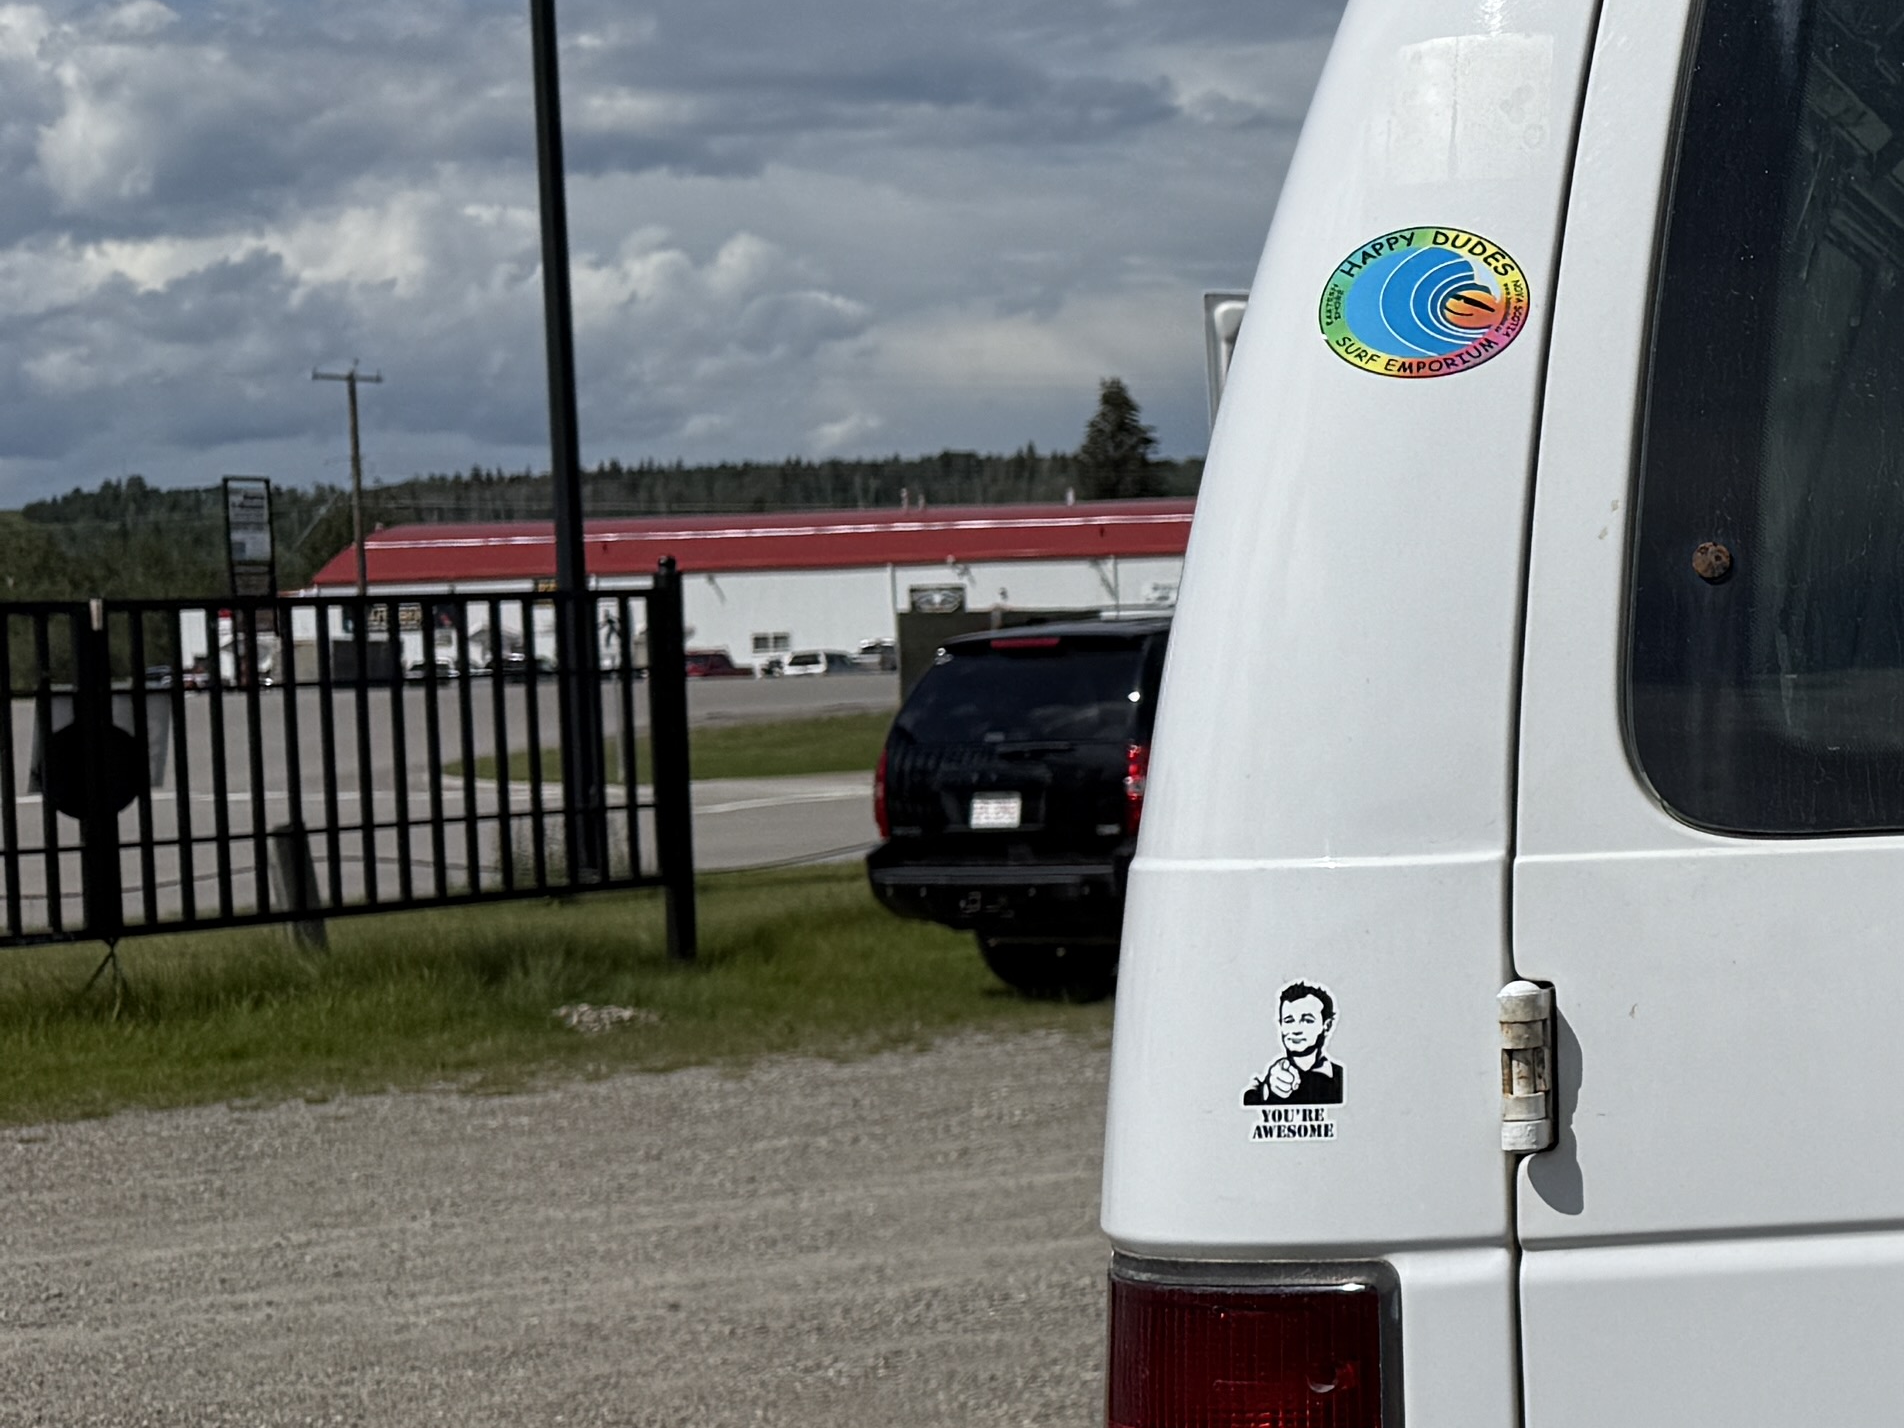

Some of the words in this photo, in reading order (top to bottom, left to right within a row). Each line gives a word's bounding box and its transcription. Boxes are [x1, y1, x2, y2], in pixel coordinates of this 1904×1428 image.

[1340, 231, 1415, 278] HAPPY
[1432, 230, 1515, 278] DUDES
[1336, 336, 1381, 365] SURF
[1384, 337, 1499, 374] EMPORIUM
[1262, 1108, 1325, 1123] YOU'RE
[1253, 1123, 1334, 1139] AWESOME
